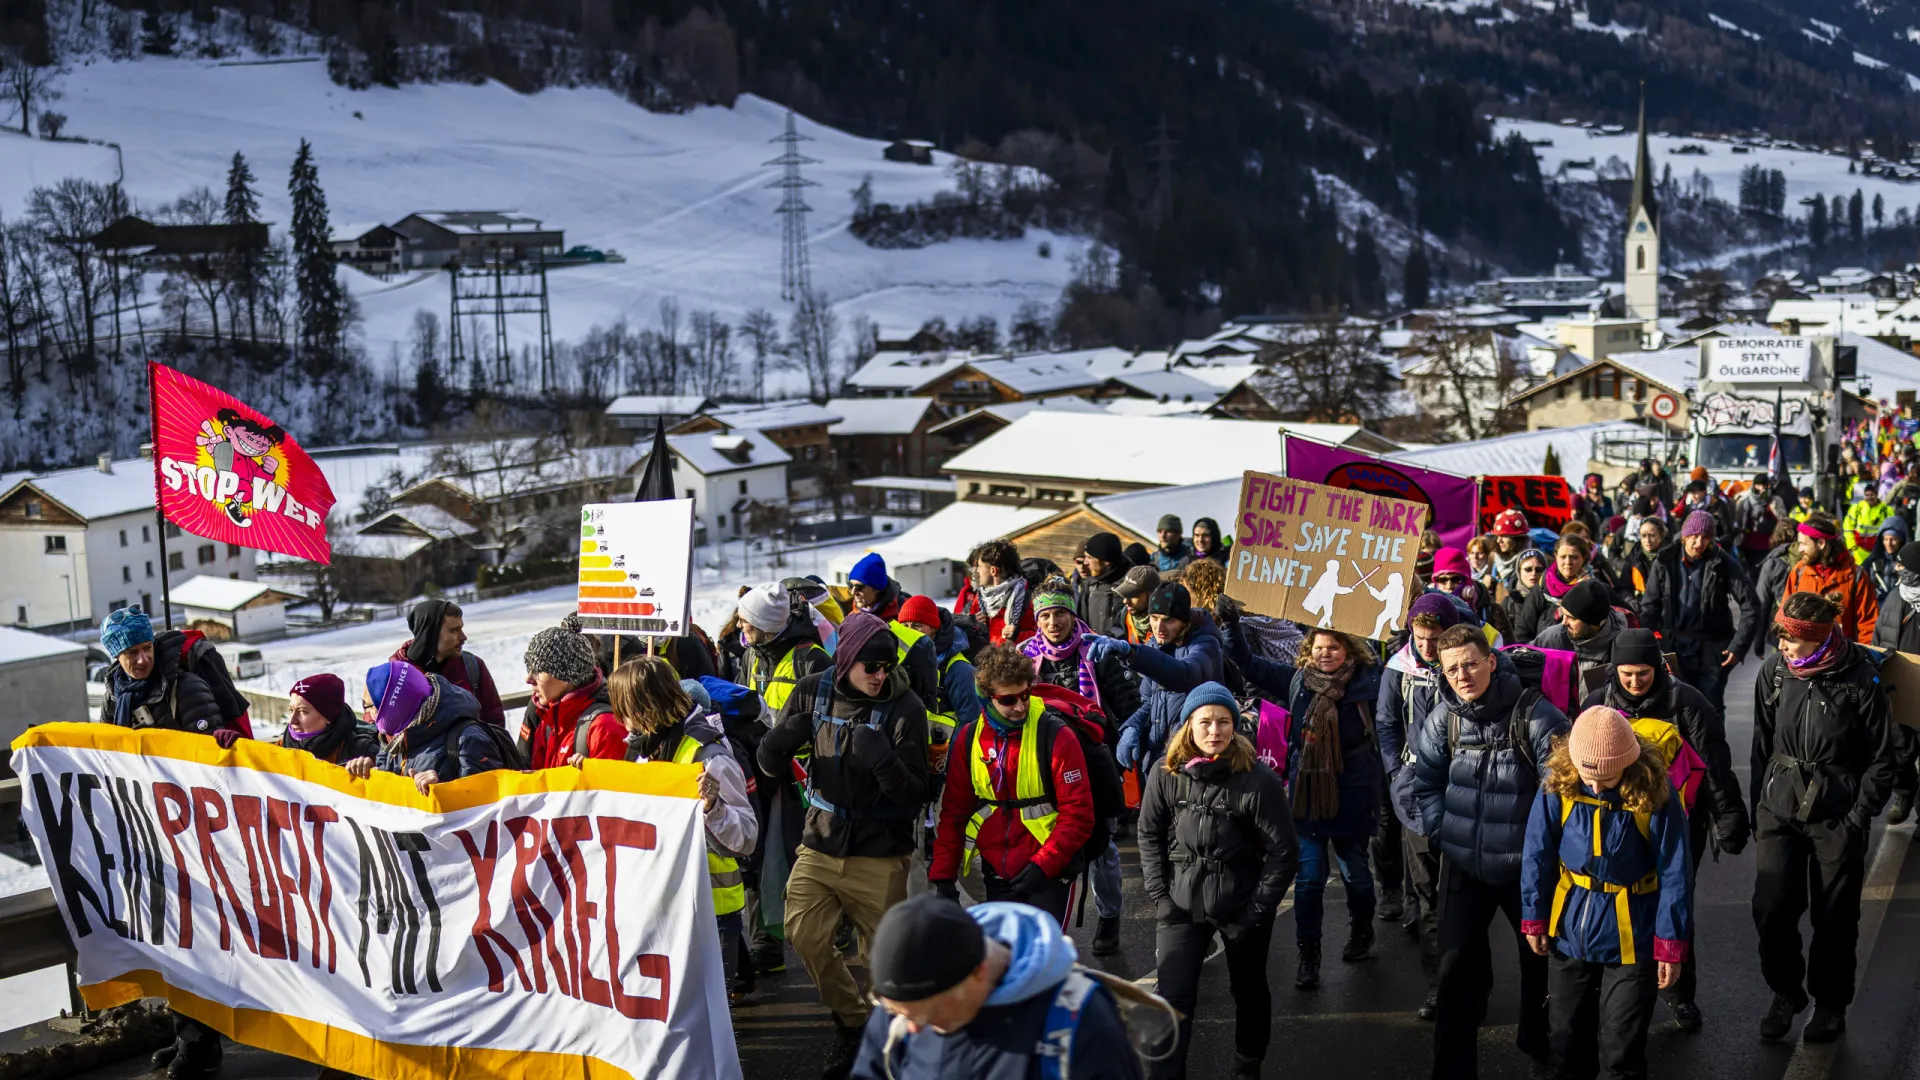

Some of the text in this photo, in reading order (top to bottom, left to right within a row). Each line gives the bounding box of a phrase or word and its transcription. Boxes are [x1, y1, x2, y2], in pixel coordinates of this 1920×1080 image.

[1718, 338, 1805, 350] DEMOKRATIE
[1741, 352, 1781, 363] STATT
[1719, 365, 1801, 377] ÖLIGARCHIE
[161, 456, 321, 531] STOP WEF
[1346, 467, 1411, 492] DAVOS
[1480, 479, 1567, 508] FREE
[1245, 476, 1426, 537] FIGHT THE DARK
[1239, 512, 1406, 563] SIDE. SAVE THE
[1236, 550, 1314, 591] PLANET.
[389, 669, 408, 707] STRIKE
[31, 771, 671, 1024] KEIN PROFIT MIT KRIEG
